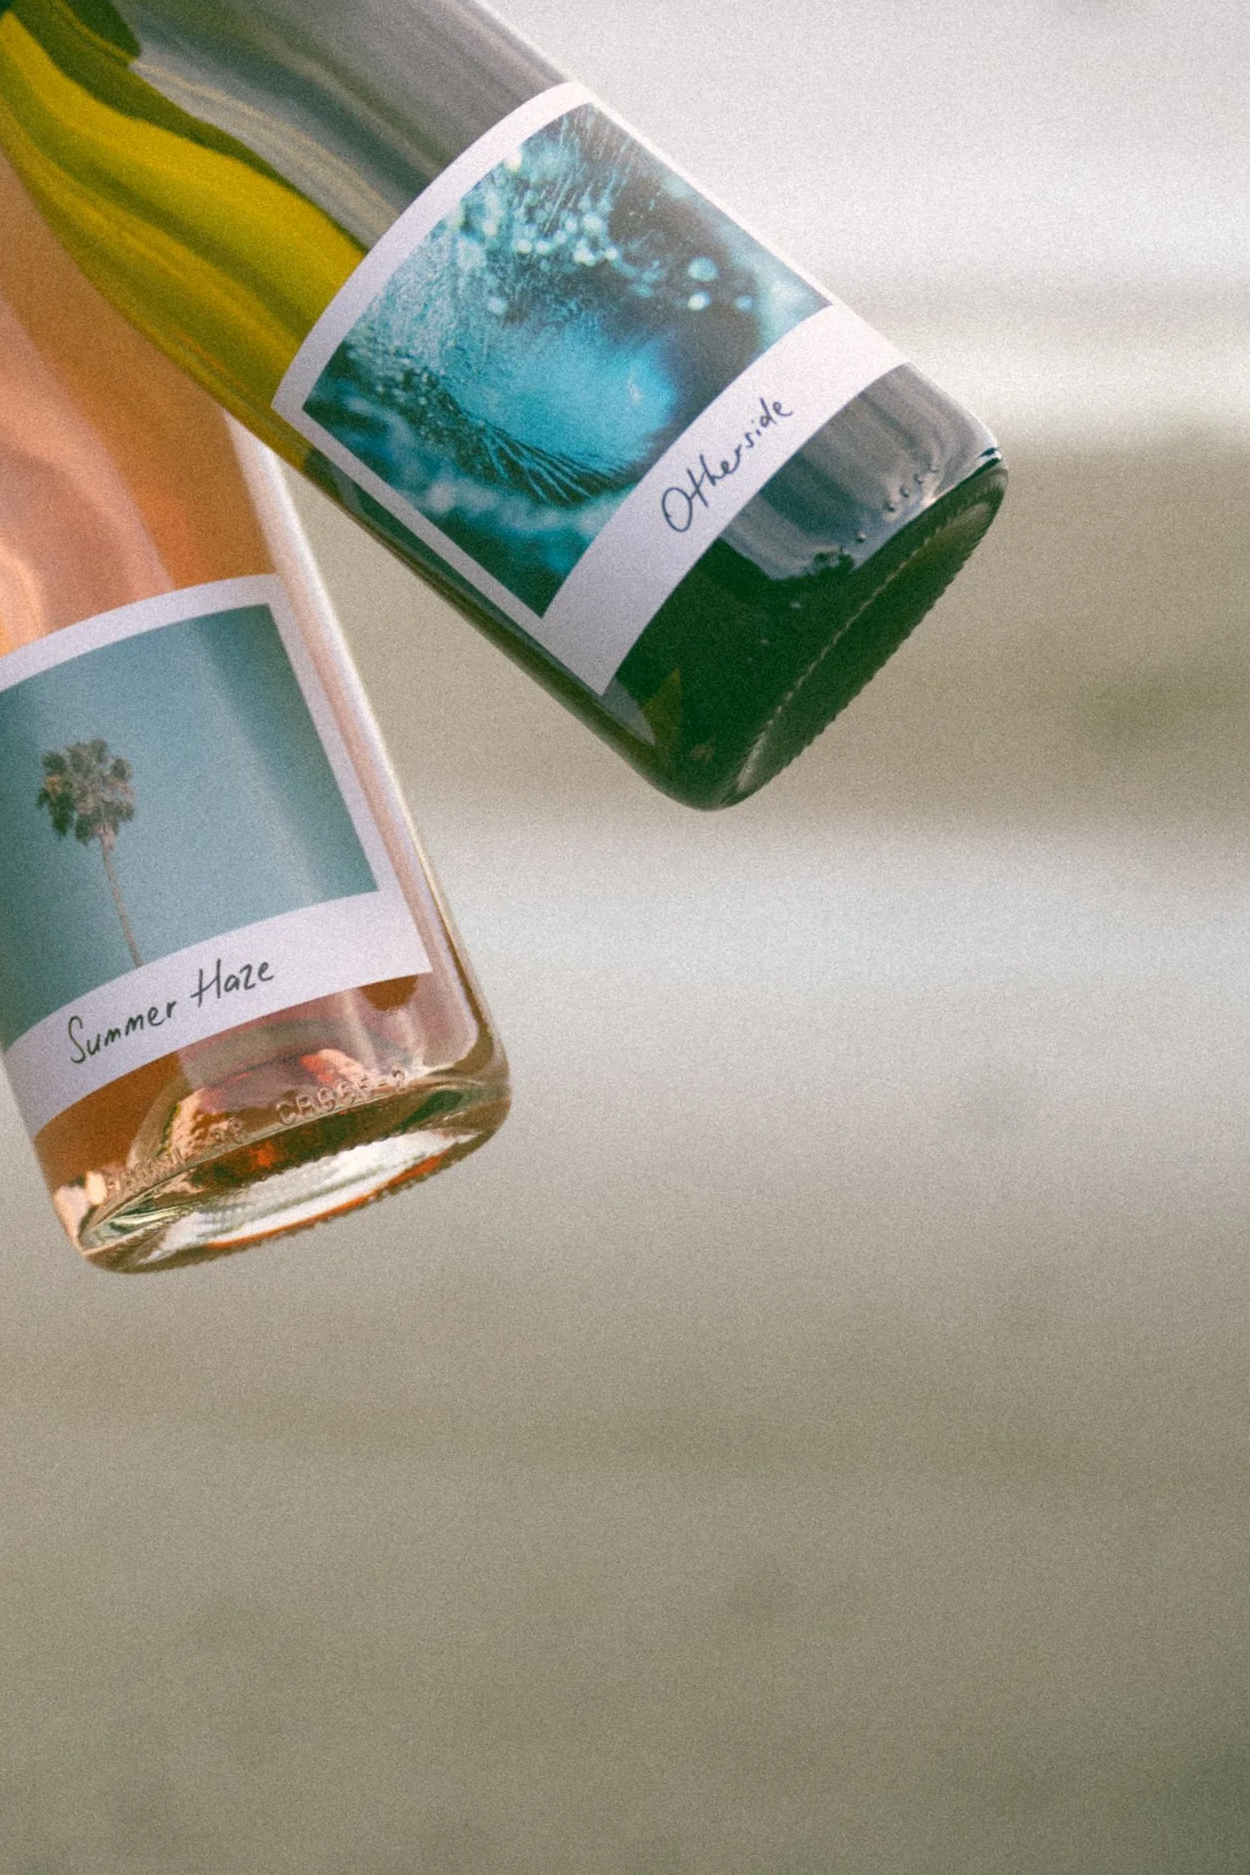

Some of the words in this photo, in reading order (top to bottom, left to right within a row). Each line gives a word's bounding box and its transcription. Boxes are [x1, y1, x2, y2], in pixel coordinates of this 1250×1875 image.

[661, 396, 794, 533] Otherside
[67, 999, 178, 1065] Summer
[190, 957, 275, 1009] Haze
